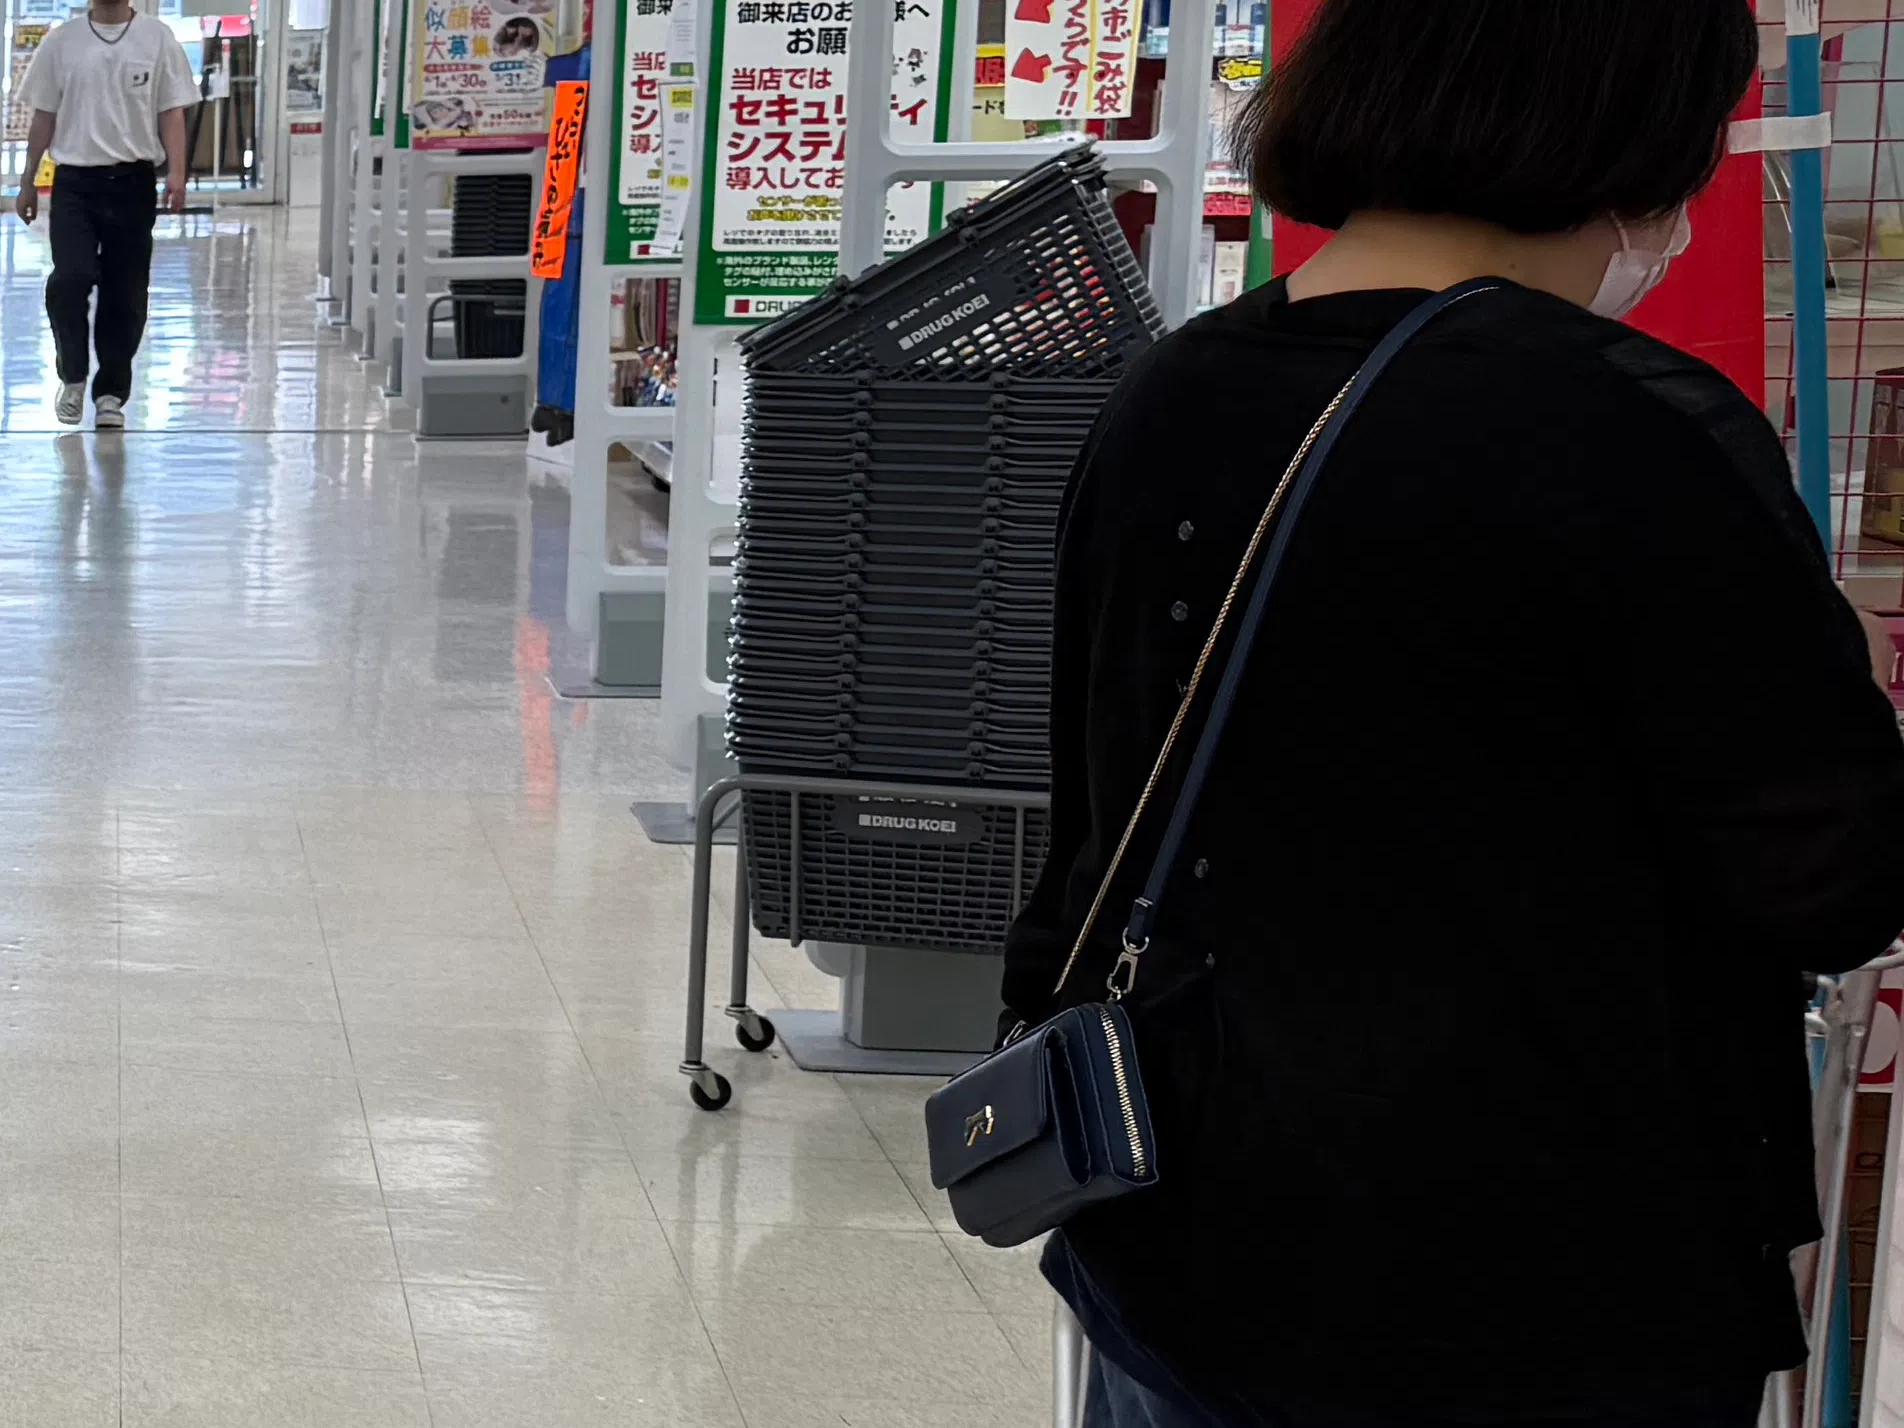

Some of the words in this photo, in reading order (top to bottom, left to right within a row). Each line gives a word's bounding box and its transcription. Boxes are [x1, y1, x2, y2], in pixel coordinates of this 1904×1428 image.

[425, 4, 493, 33] 似顔絵
[424, 34, 491, 61] 大募集
[730, 67, 832, 91] 当店では
[909, 313, 955, 344] DRUG
[950, 293, 991, 321] KOEI
[872, 815, 917, 830] DRUG
[918, 818, 957, 833] KOEI
